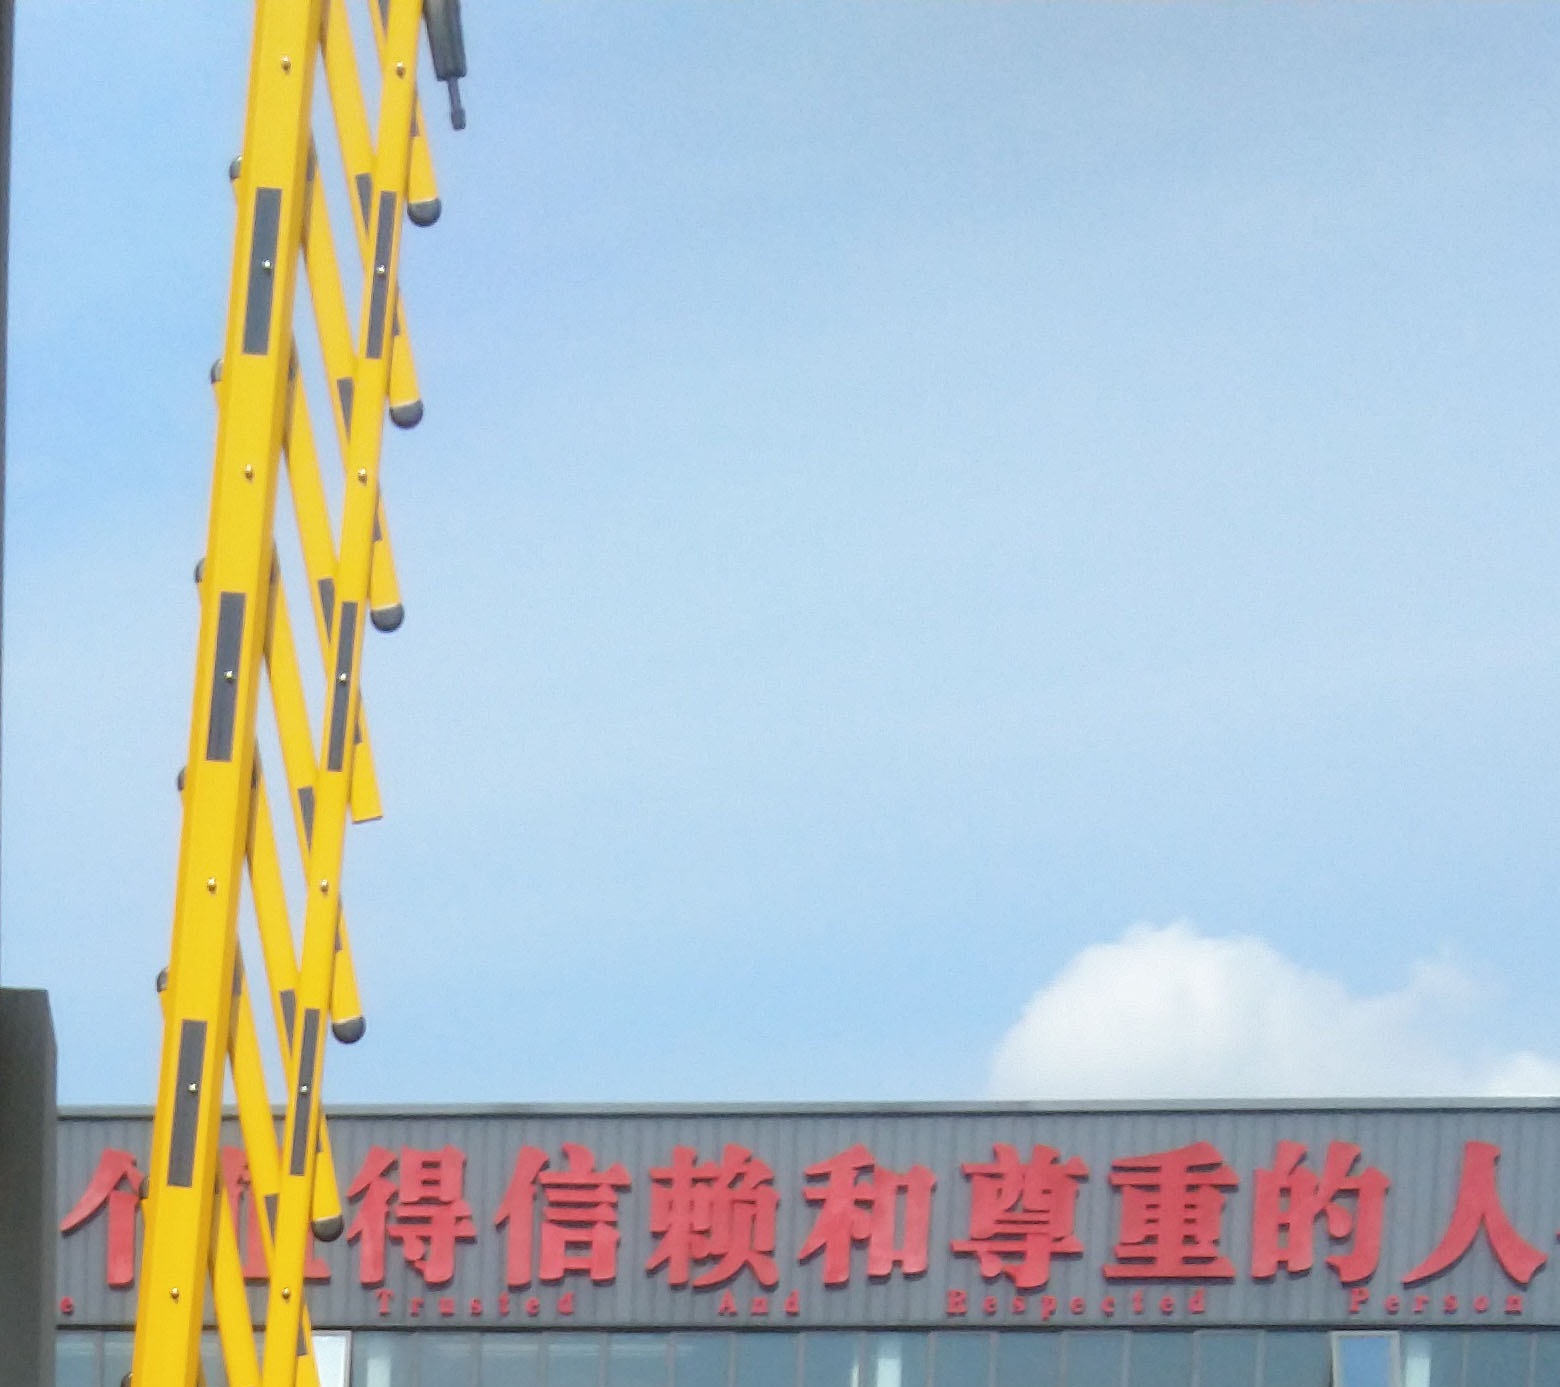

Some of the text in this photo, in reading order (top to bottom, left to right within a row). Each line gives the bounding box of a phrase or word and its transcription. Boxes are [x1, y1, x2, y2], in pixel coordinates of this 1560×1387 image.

[60, 1140, 1548, 1288] 个得信赖和尊重的人
[375, 1287, 576, 1317] Trusted
[717, 1288, 800, 1316] And
[945, 1288, 1206, 1321] Respected
[1348, 1286, 1525, 1315] Person
